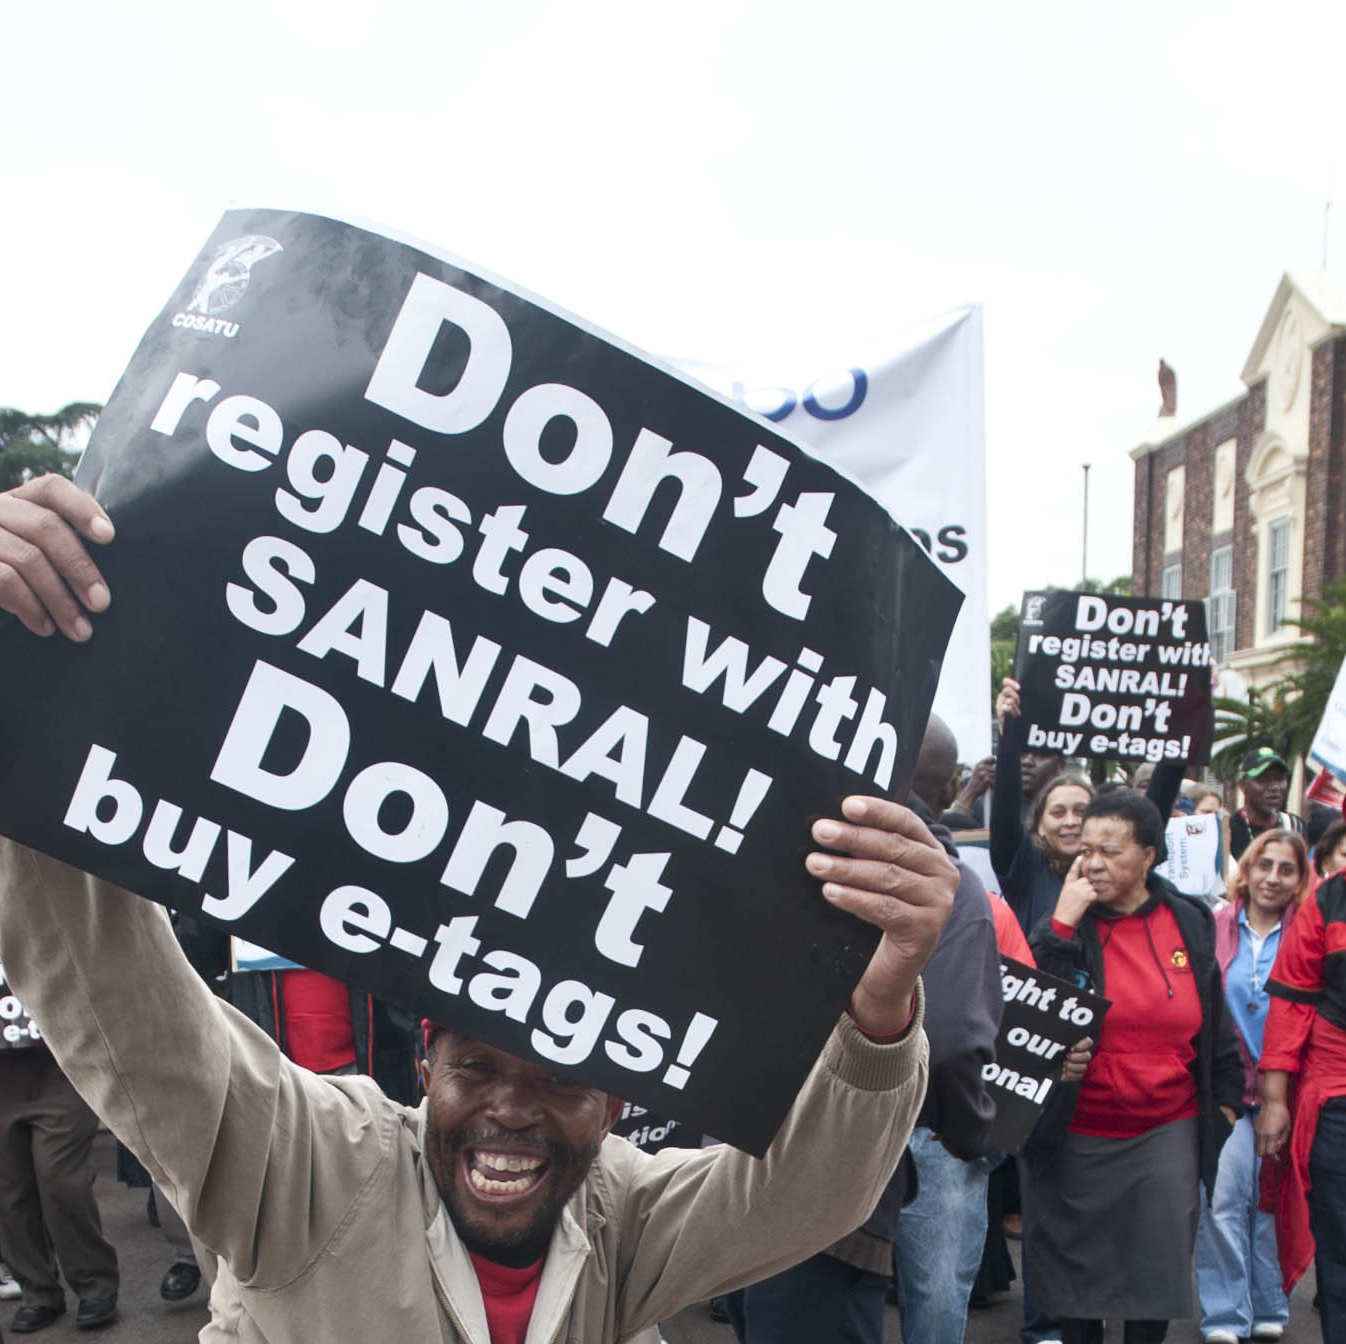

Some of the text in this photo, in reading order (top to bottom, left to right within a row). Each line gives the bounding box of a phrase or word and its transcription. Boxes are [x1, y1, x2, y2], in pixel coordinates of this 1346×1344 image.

[172, 313, 240, 338] COSATU
[364, 272, 838, 622] Don't
[148, 368, 899, 791] register with
[1075, 595, 1189, 639] Don't
[1028, 634, 1151, 663] register
[225, 534, 773, 856] SANRAL!
[1055, 664, 1188, 697] SANRAL!
[1059, 692, 1172, 733] Don't
[1027, 723, 1192, 763] buy e-tags!
[209, 659, 675, 969] Don't
[62, 742, 720, 1091] buy e-tags!
[1058, 997, 1094, 1027] to
[1007, 1027, 1066, 1060] our
